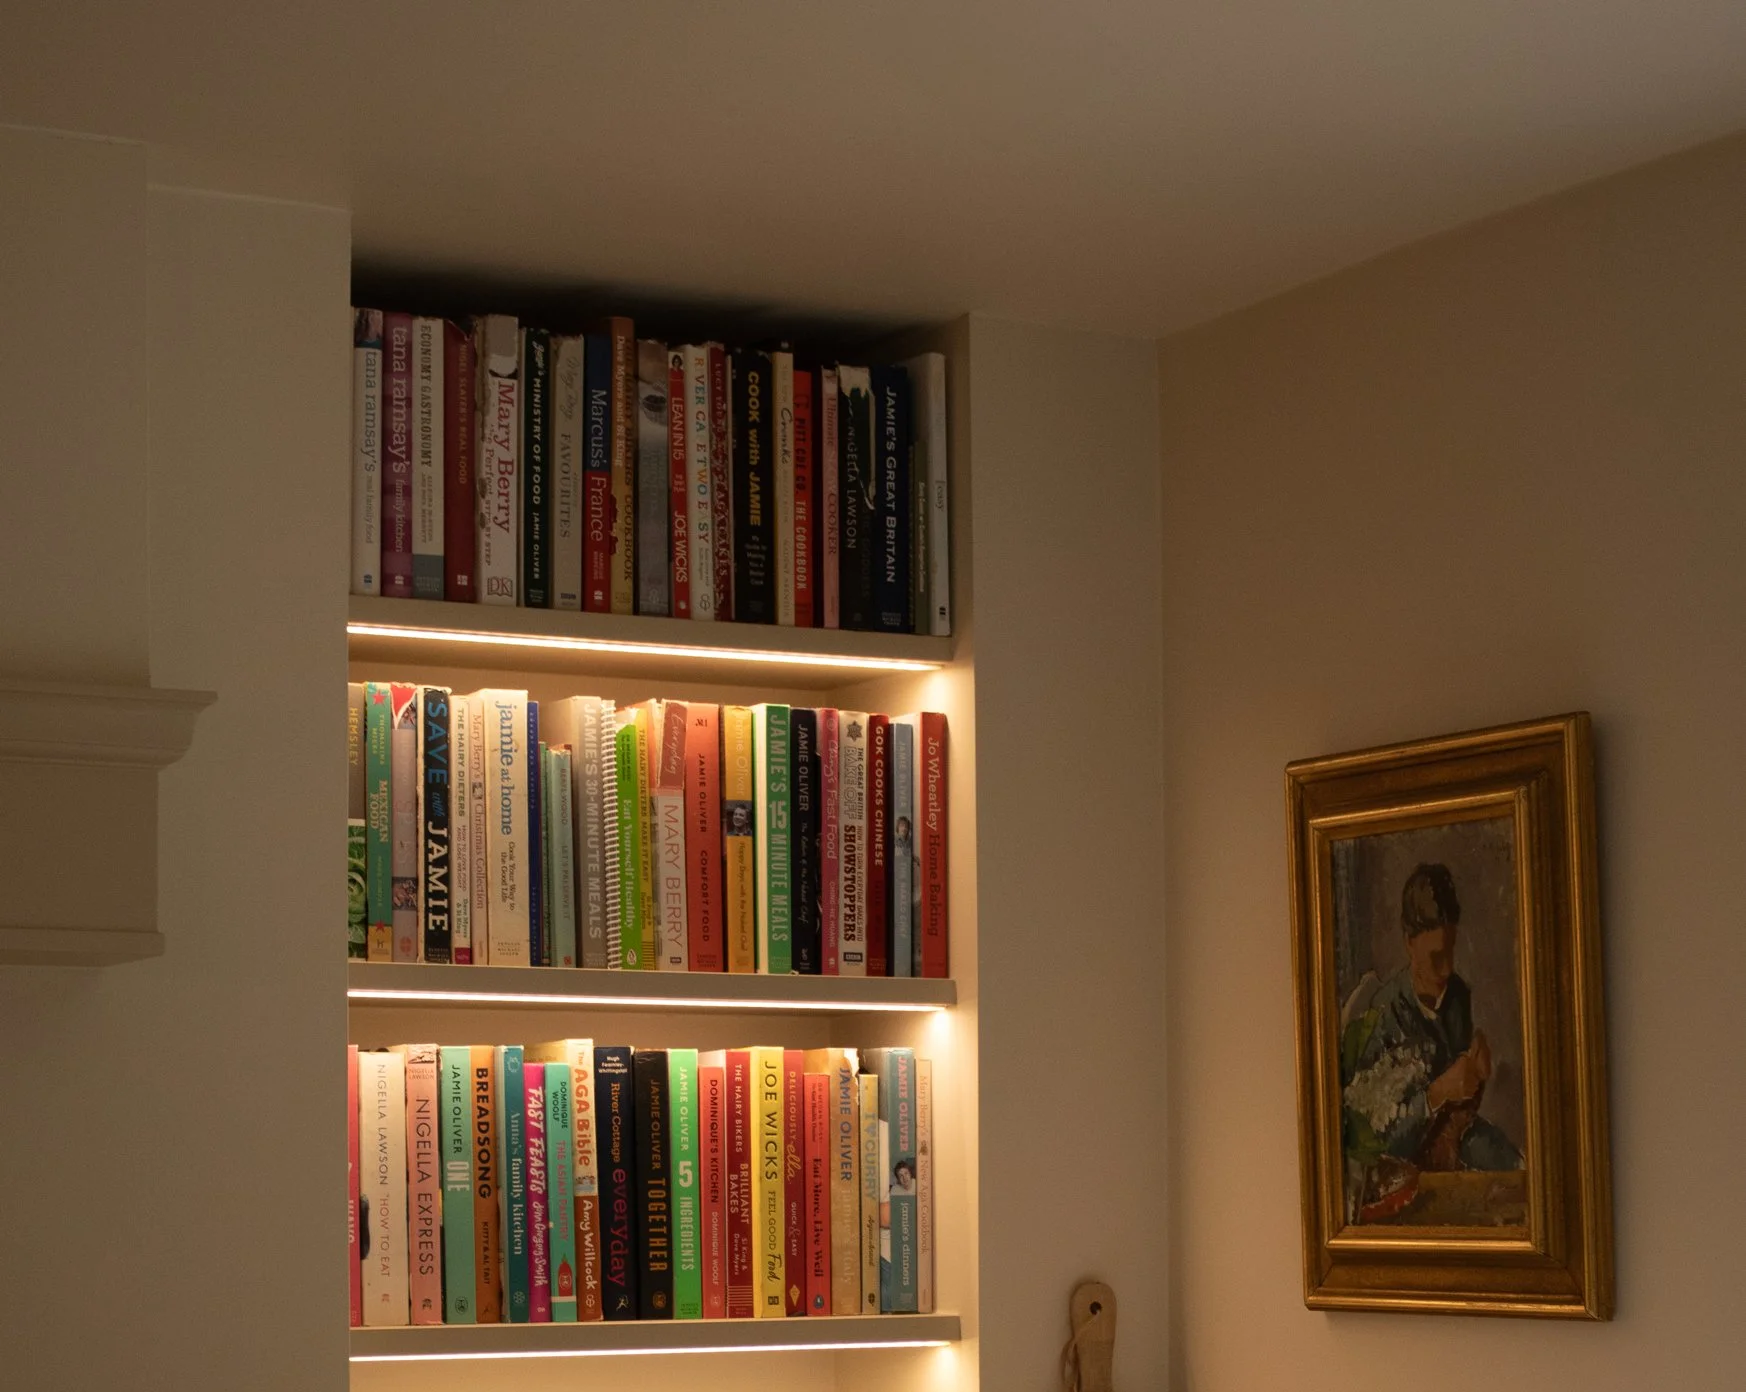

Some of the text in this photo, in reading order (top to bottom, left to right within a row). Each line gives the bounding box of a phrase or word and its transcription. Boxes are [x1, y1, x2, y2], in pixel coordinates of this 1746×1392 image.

[365, 351, 378, 390] tana
[421, 325, 431, 381] ECONOMY
[614, 364, 625, 398] Myers
[616, 335, 625, 361] Dave
[361, 394, 378, 472] ramsay's
[421, 385, 432, 467] GASTRONOMY
[616, 401, 625, 422] and
[748, 371, 759, 422] COOK
[388, 327, 410, 552] tana ramsay's family kitchen
[494, 383, 514, 533] Mary Berry
[590, 389, 607, 541] Marcus's France
[614, 438, 625, 467] King
[749, 429, 759, 465] with
[364, 493, 373, 521] family
[559, 433, 571, 538] FAVOURITES
[749, 472, 761, 526] JAMIE
[885, 386, 896, 584] JAMIE'S GREAT BRITAIN
[365, 523, 373, 544] food
[532, 512, 541, 580] JAMIE OLIVER
[675, 511, 688, 583] JOE WICKS
[795, 500, 806, 589] THE COOKBOOK
[350, 708, 358, 766] HEMSLEY
[457, 708, 465, 729] THE
[457, 732, 465, 766] HAIRY
[495, 702, 517, 835] jamie at home
[798, 724, 809, 811] JAMIE OLIVER
[824, 740, 838, 859] Ching's Fast Food
[844, 746, 857, 820] BAKE OFF
[875, 726, 884, 866] GOK COOKS CHINESE
[927, 737, 941, 830] Jo Wheatley
[370, 793, 379, 828] FOOD
[379, 780, 388, 842] MEXICAN
[428, 702, 448, 930] SAVE with JAMIE
[584, 704, 601, 938] JAMIE'S 30-MINUTE MEALS
[771, 715, 788, 941] JAMIE'S 15 MINUTE MEALS
[475, 803, 485, 909] Christmas Collection
[664, 805, 682, 947] MARY BERRY
[701, 851, 709, 904] COMFORT
[844, 825, 856, 941] SHOWSTOPPERS
[927, 834, 941, 936] Home Baking
[378, 1065, 388, 1185] NIGELLA LAWSON
[452, 1065, 462, 1154] JAMIE OLIVER
[477, 1068, 491, 1198] BREADSONG
[560, 1082, 568, 1128] DOMINIQUE
[575, 1069, 589, 1113] AGA
[651, 1080, 661, 1170] JAMIE OLIVER
[680, 1067, 689, 1151] JAMIE OLIVER
[765, 1061, 777, 1180] JOE WICKS
[840, 1068, 852, 1180] JAMIE OLIVER
[898, 1057, 909, 1152] JAMIE OLIVER
[447, 1161, 469, 1191] ONE
[528, 1087, 544, 1194] FAST FEASTS
[577, 1119, 590, 1167] Bible
[710, 1080, 719, 1203] DOMINIQUE'S KITCHEN
[735, 1119, 743, 1153] BIKERS
[787, 1144, 800, 1181] ella
[416, 1099, 433, 1275] NIGELLA EXPRESS
[511, 1112, 523, 1255] Anna's family kitchen
[608, 1083, 629, 1286] River Cottage everyday
[648, 1178, 667, 1271] TOGETHER
[679, 1161, 693, 1271] 5 INGREDIENTS
[730, 1174, 739, 1213] BAKES
[740, 1163, 749, 1224] BRILLIANT
[920, 1160, 929, 1254] New Aga Cookbook
[483, 1254, 490, 1264] AL
[580, 1200, 597, 1289] Amy Willcock
[767, 1254, 781, 1282] Food
[769, 1218, 777, 1250] GOOD
[900, 1202, 911, 1286] jamie's dinners
